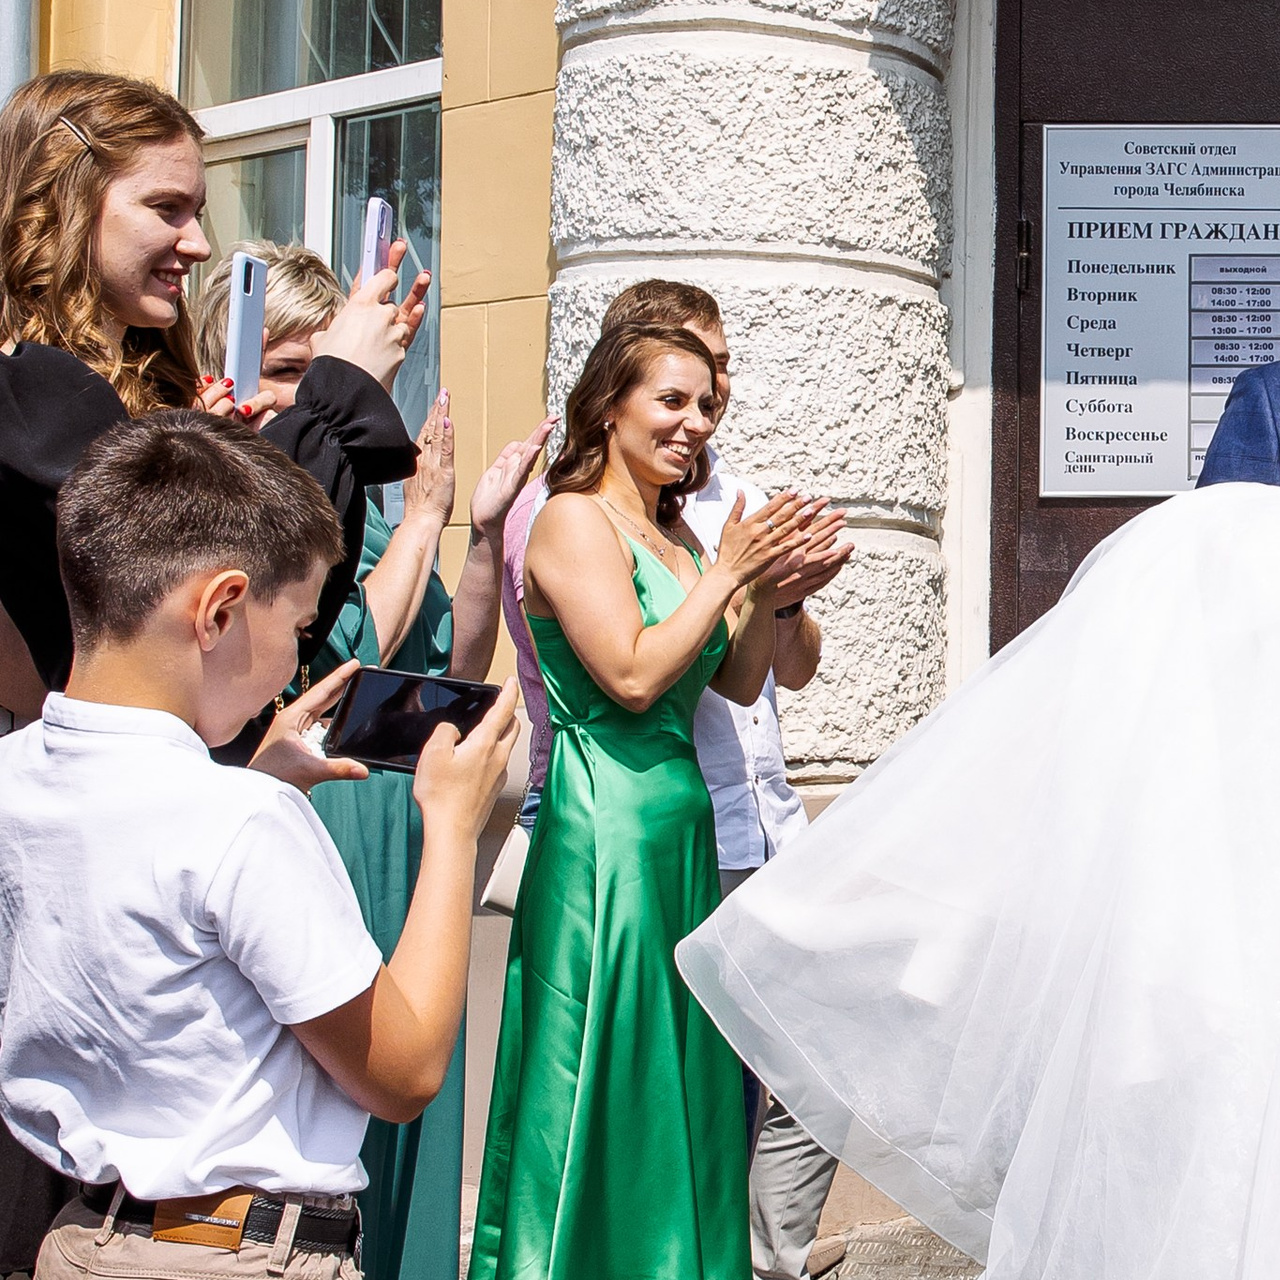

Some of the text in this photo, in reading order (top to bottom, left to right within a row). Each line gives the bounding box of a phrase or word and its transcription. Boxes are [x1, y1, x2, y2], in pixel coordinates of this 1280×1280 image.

[1123, 140, 1238, 157] Советский отдел
[1059, 161, 1142, 178] Управления
[1145, 161, 1188, 176] ЗАГС
[1113, 183, 1246, 199] города Челябинска
[1067, 221, 1153, 239] ПРИЕМ
[1066, 259, 1177, 276] Понедельник
[1219, 266, 1268, 274] выходной
[1066, 287, 1138, 305] Вторник
[1211, 287, 1237, 295] 08:30
[1245, 287, 1272, 295] 12:00
[1211, 299, 1237, 307] 14:00
[1245, 299, 1272, 307] 17:00
[1066, 315, 1117, 332] Среда
[1211, 315, 1238, 323] 08:30
[1245, 314, 1272, 322] 12:00
[1211, 326, 1237, 334] 13:00
[1246, 326, 1272, 334] 17:00
[1066, 343, 1134, 361] Четверг
[1214, 342, 1240, 350] 08:30
[1248, 342, 1274, 350] 12:00
[1213, 355, 1240, 363] 14:00
[1249, 354, 1275, 362] 17:00
[1065, 371, 1138, 387] Пятница
[1065, 398, 1134, 416] Суббота
[1065, 426, 1169, 444] Воскресенье
[1064, 450, 1154, 466] Санитарный
[1064, 463, 1096, 474] день
